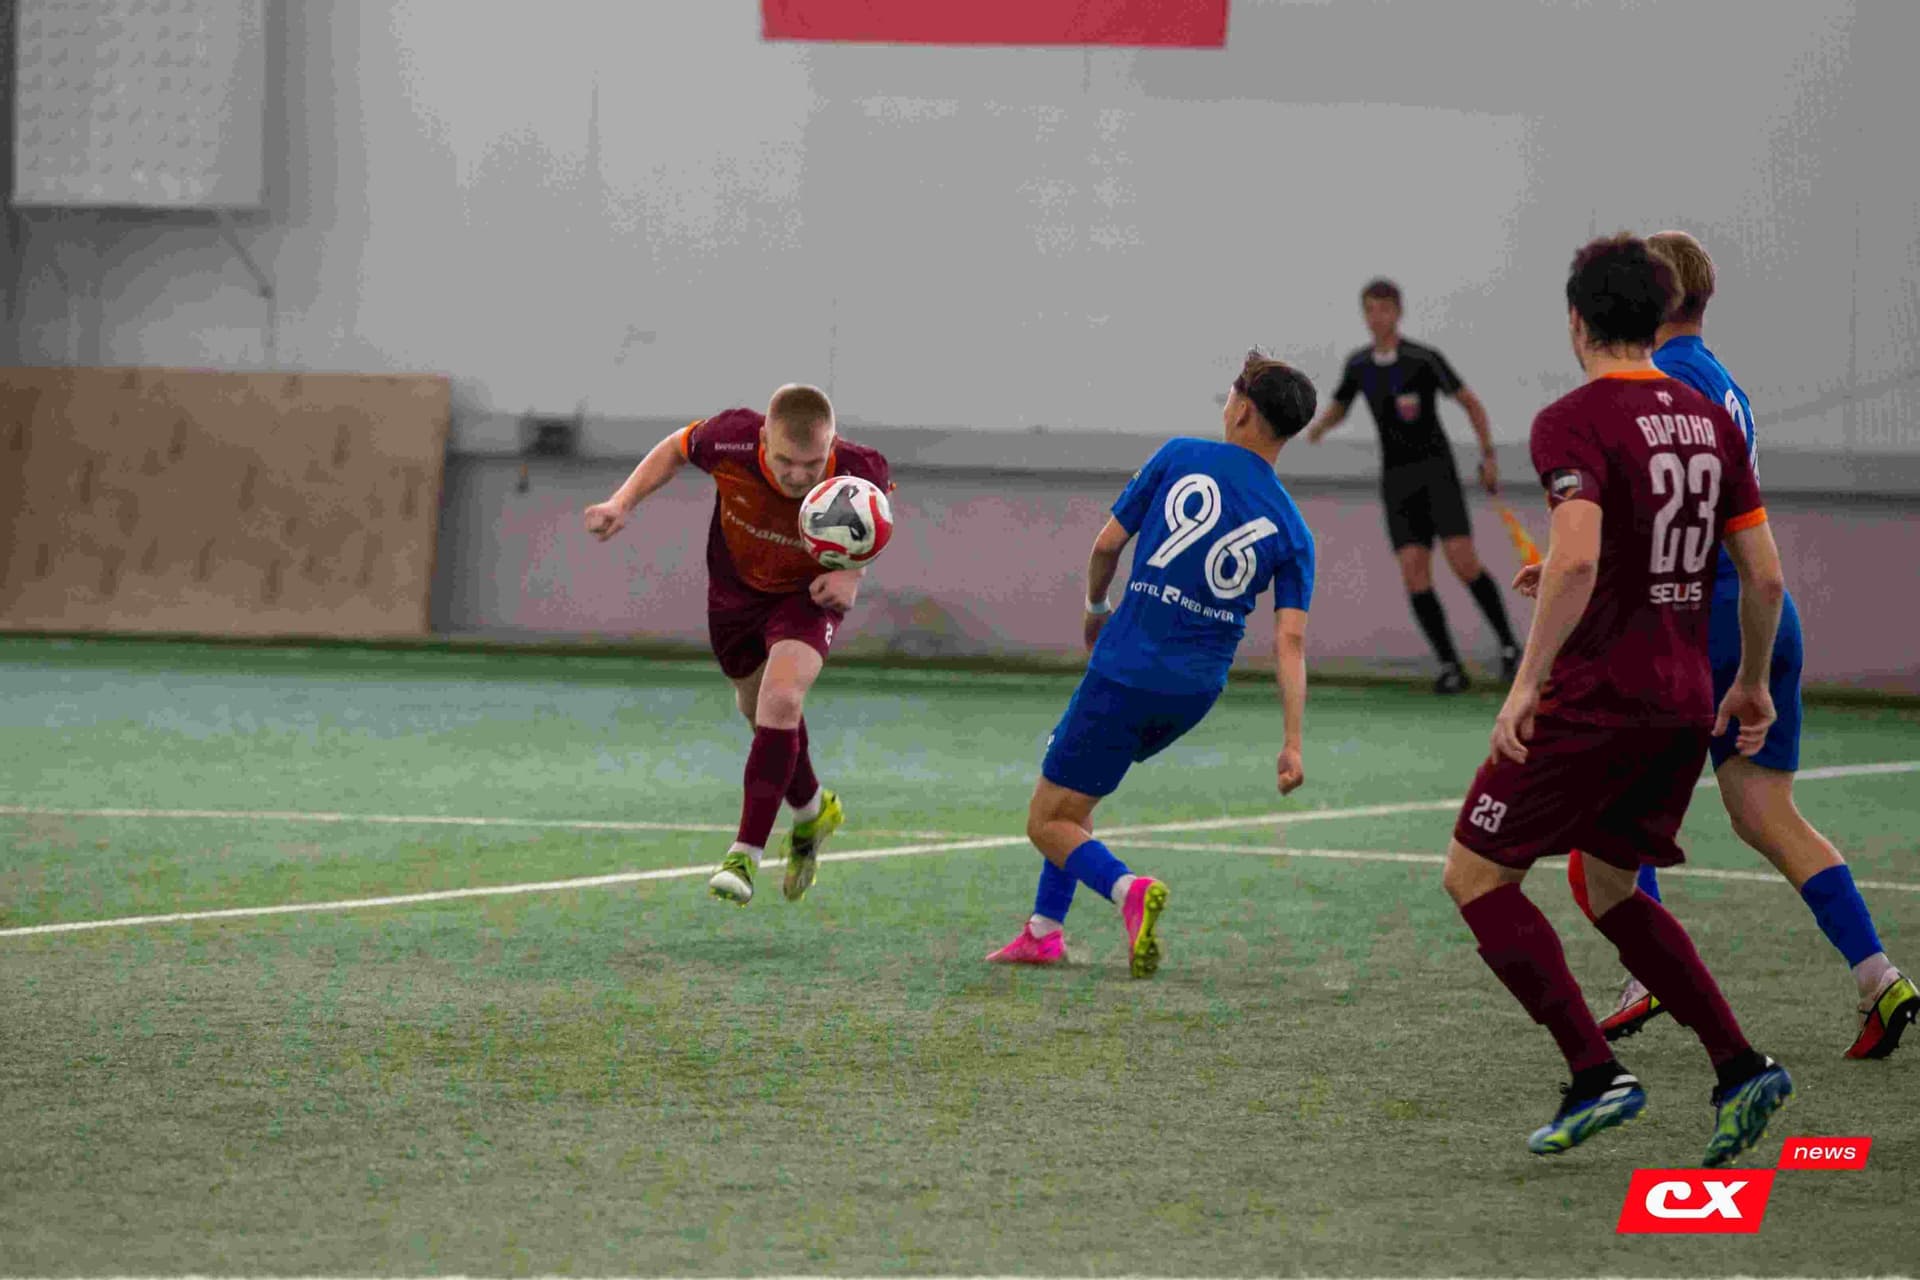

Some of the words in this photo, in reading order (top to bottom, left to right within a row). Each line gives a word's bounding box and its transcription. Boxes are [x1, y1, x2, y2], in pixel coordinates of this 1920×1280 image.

[1146, 473, 1279, 599] 96
[1649, 453, 1722, 574] 23
[1180, 595, 1201, 614] RED
[1203, 606, 1235, 623] RIVER
[1469, 792, 1508, 833] 23
